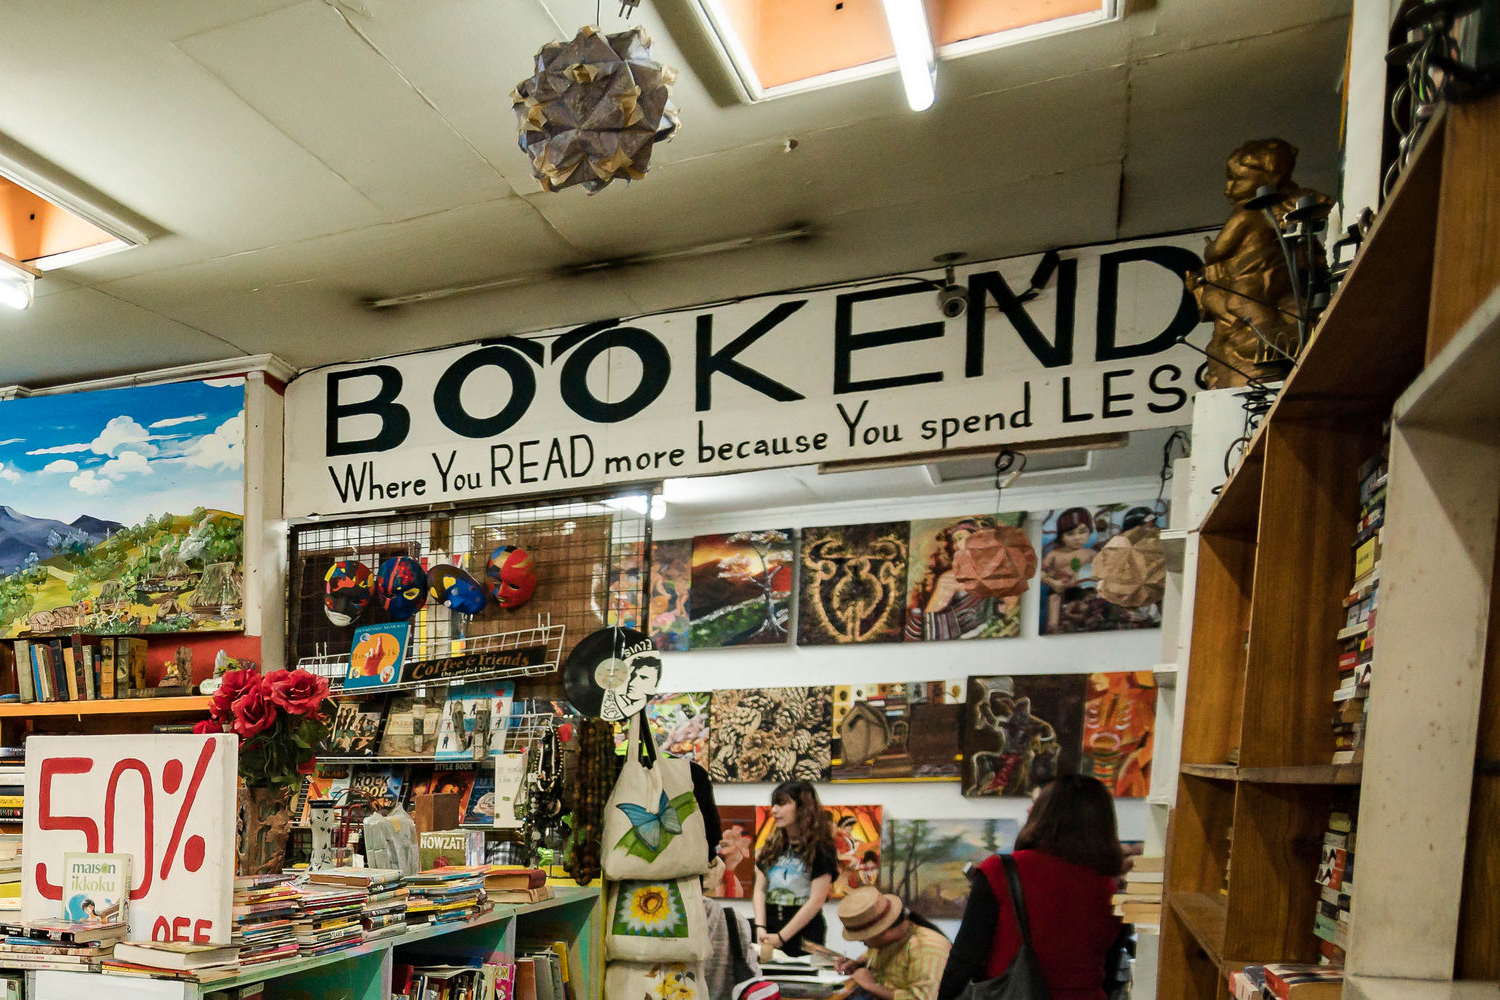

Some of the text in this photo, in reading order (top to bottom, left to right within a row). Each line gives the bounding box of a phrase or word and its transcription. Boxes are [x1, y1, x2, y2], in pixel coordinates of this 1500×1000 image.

[326, 245, 1206, 457] BOOKEND
[328, 461, 427, 503] Where
[433, 450, 483, 493] You
[491, 433, 594, 487] READ
[605, 448, 685, 474] more
[698, 420, 828, 463] because
[837, 400, 903, 448] You
[921, 381, 1034, 449] spend
[624, 638, 653, 658] ELVIS
[411, 660, 461, 681] Coffee
[477, 652, 530, 667] Friends
[355, 775, 390, 788] ROCK
[35, 737, 217, 901] 50%
[72, 862, 116, 875] maison
[71, 875, 116, 892] ikkoku
